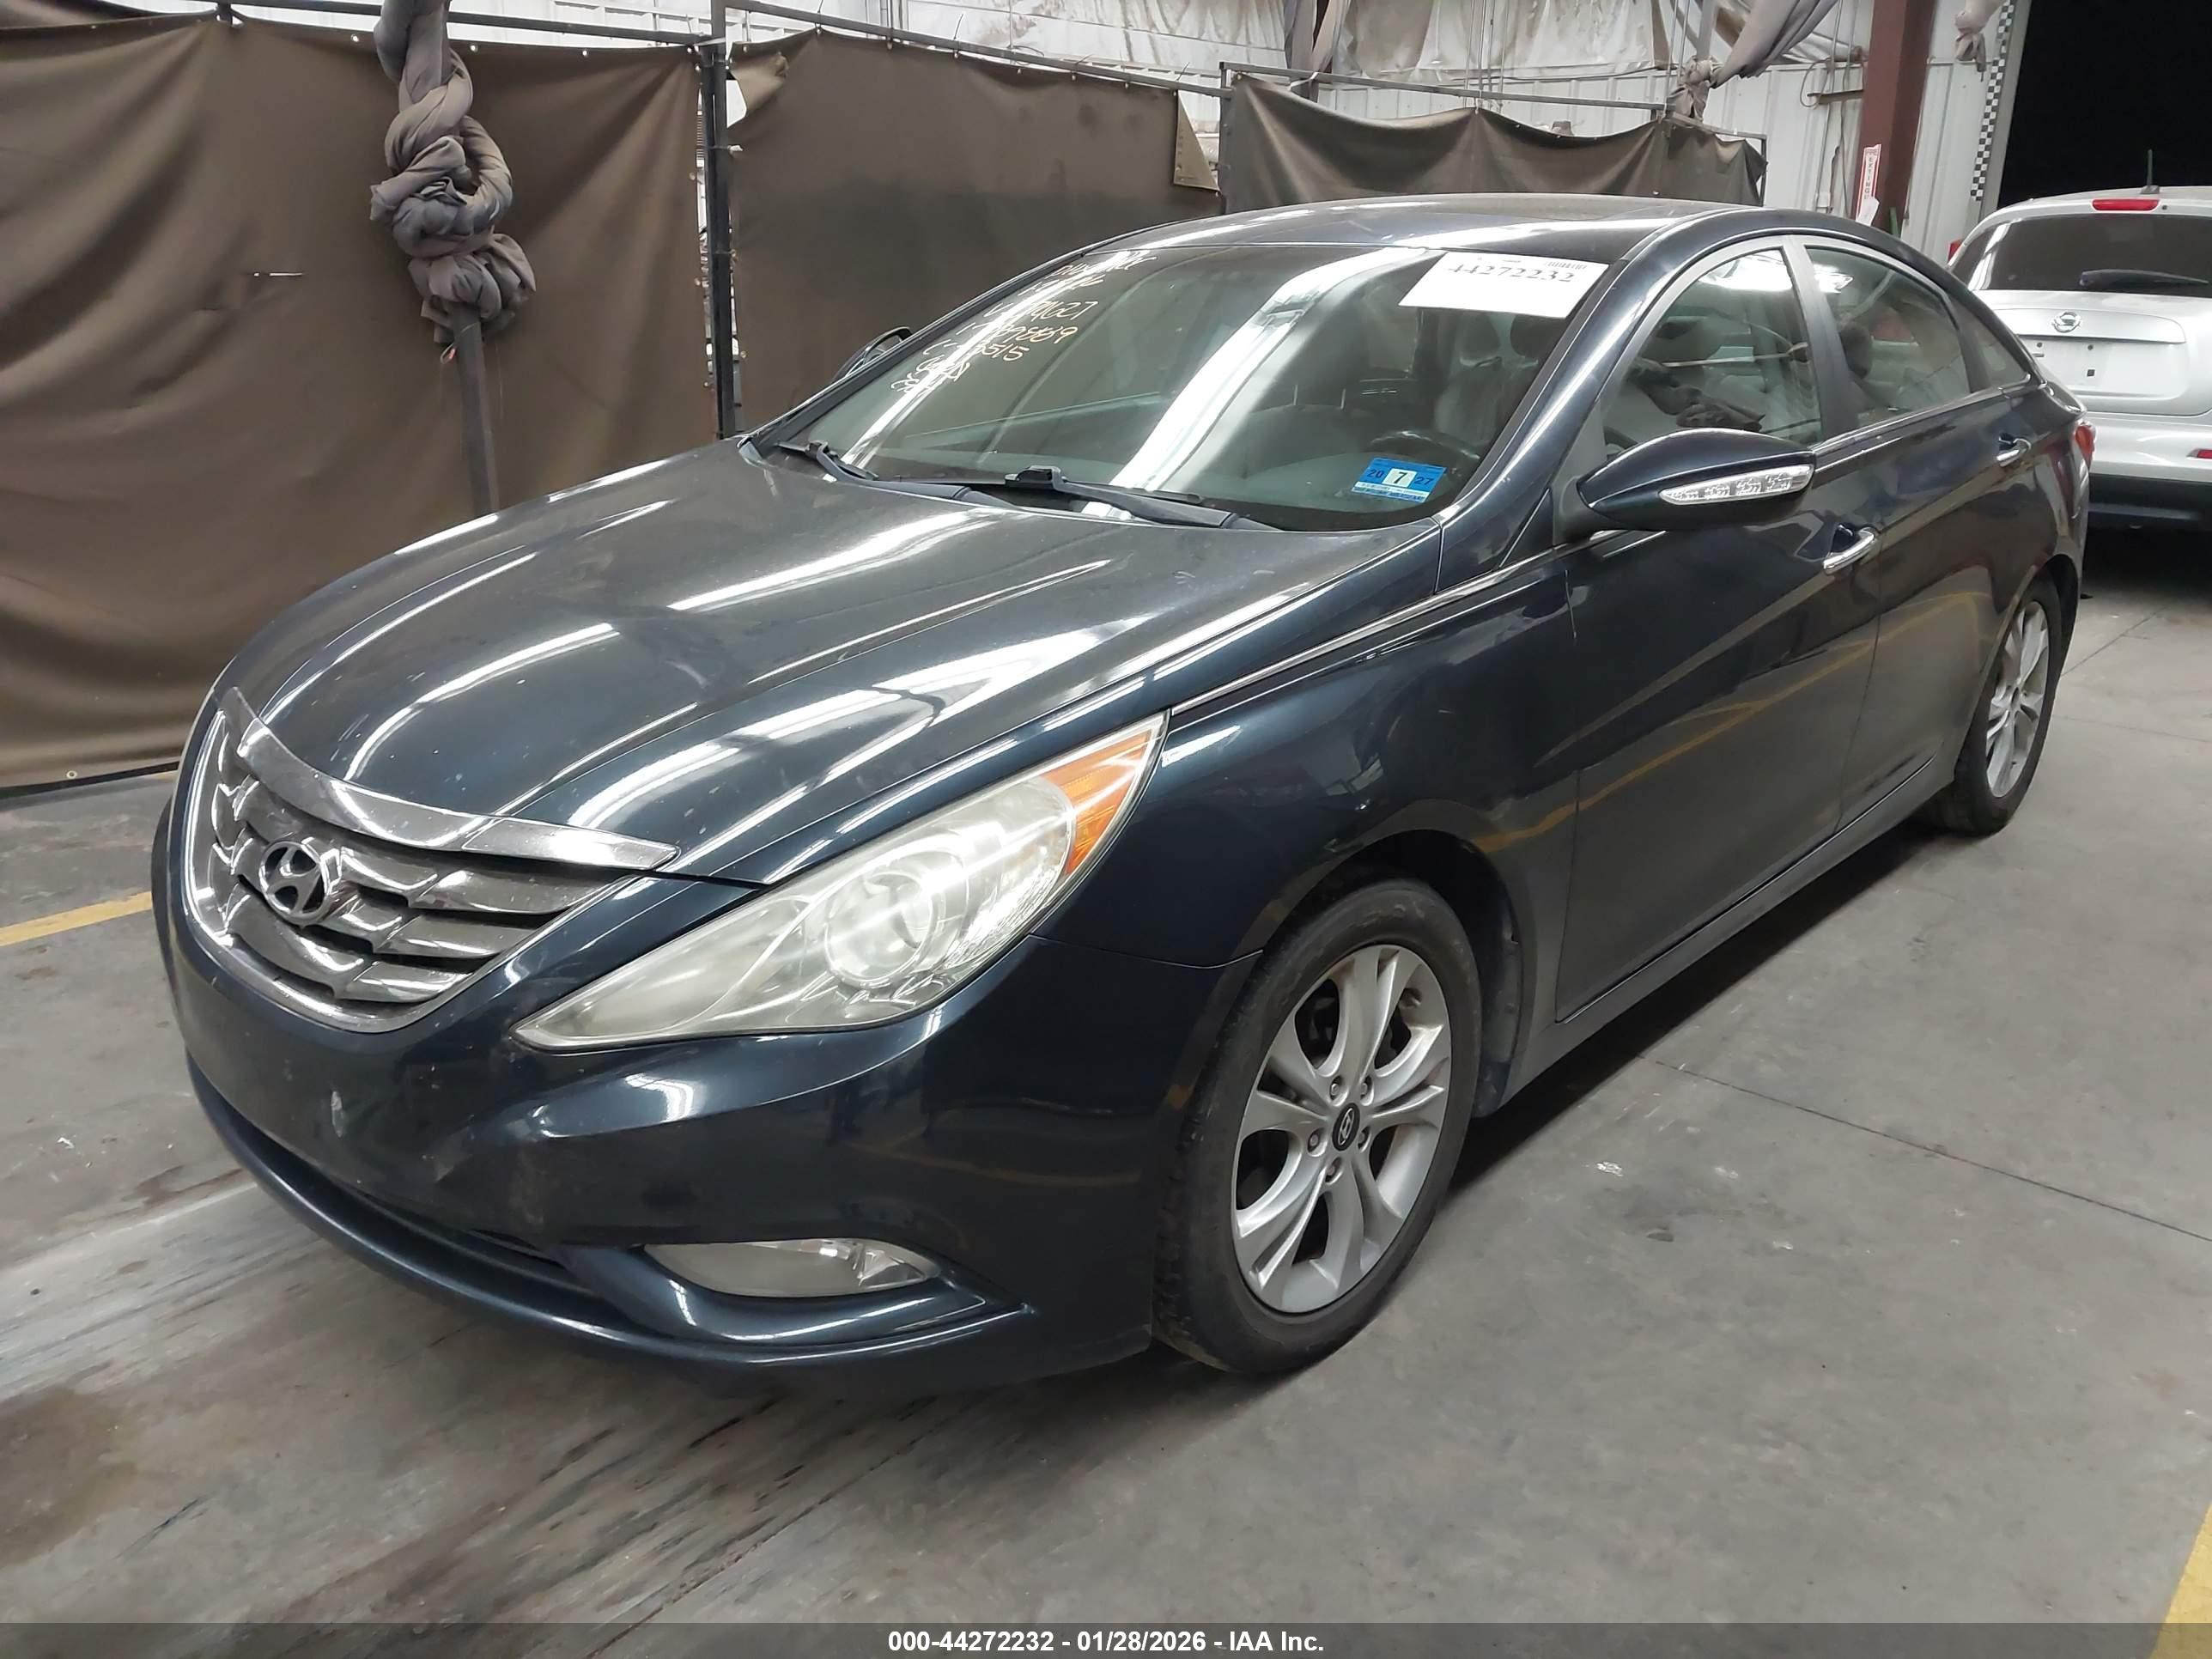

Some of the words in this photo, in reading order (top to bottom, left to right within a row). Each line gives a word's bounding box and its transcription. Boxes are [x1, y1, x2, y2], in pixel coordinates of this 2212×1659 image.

[1449, 264, 1575, 283] 44272232
[1366, 469, 1384, 478] 20
[1393, 471, 1407, 484] 7
